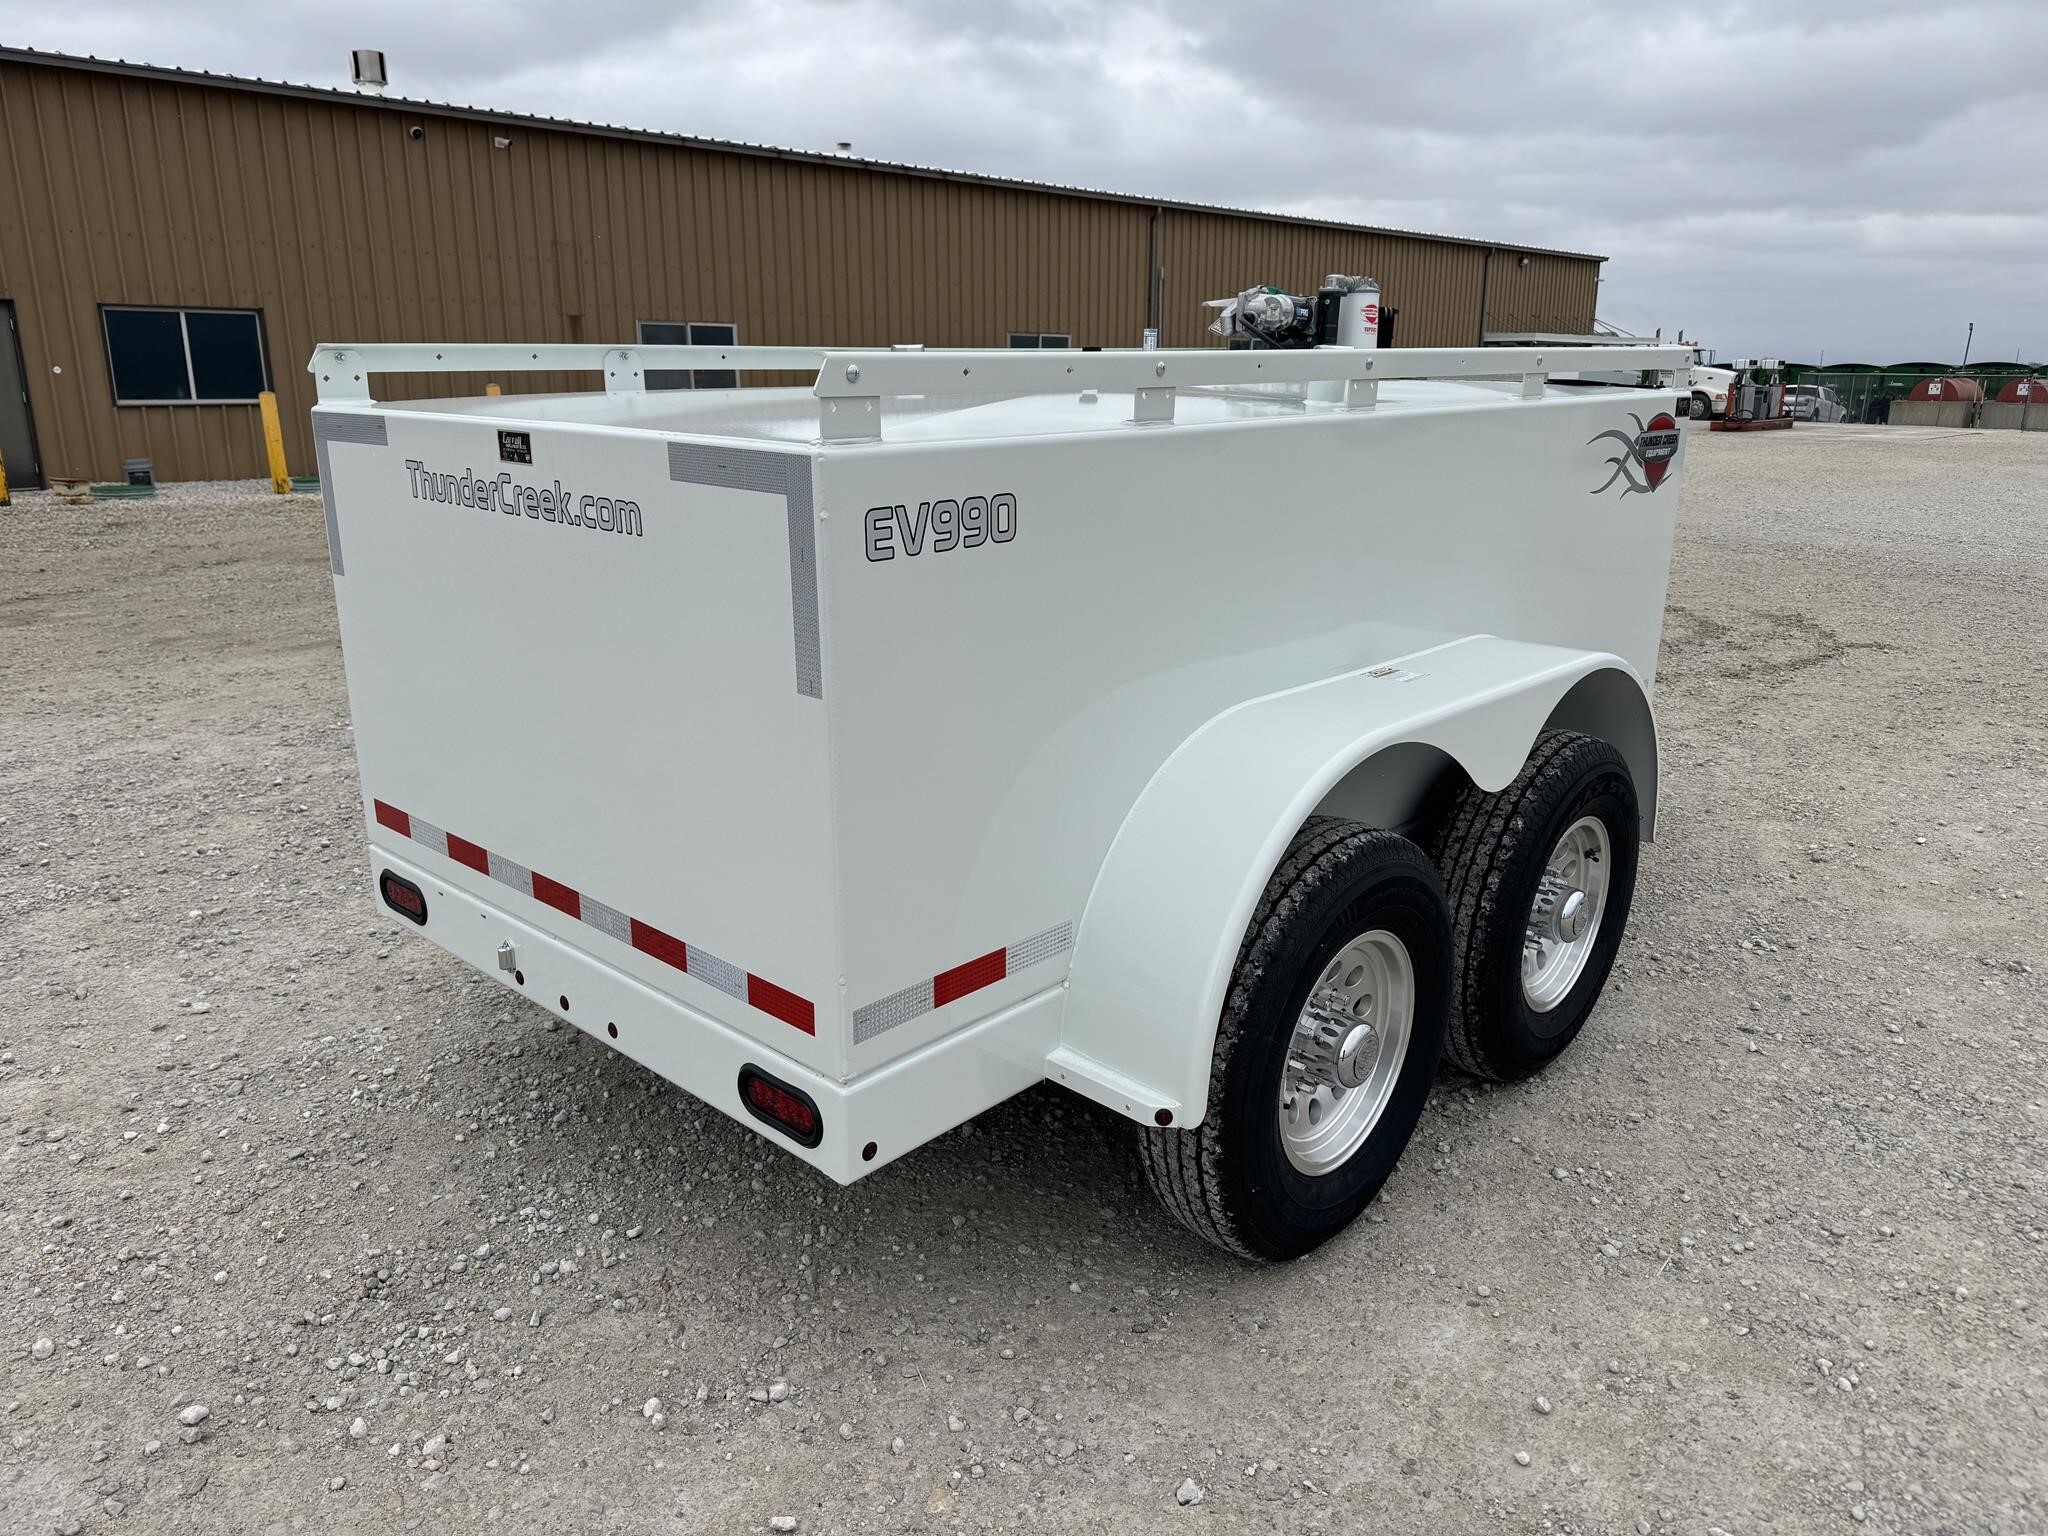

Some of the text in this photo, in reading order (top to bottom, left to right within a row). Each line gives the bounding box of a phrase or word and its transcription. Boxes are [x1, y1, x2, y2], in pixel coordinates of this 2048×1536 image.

[1640, 436, 1662, 447] THUNDER
[1645, 448, 1671, 458] EQUIPMENT
[405, 459, 643, 537] ThunderCreek.com
[865, 493, 1016, 562] EV990
